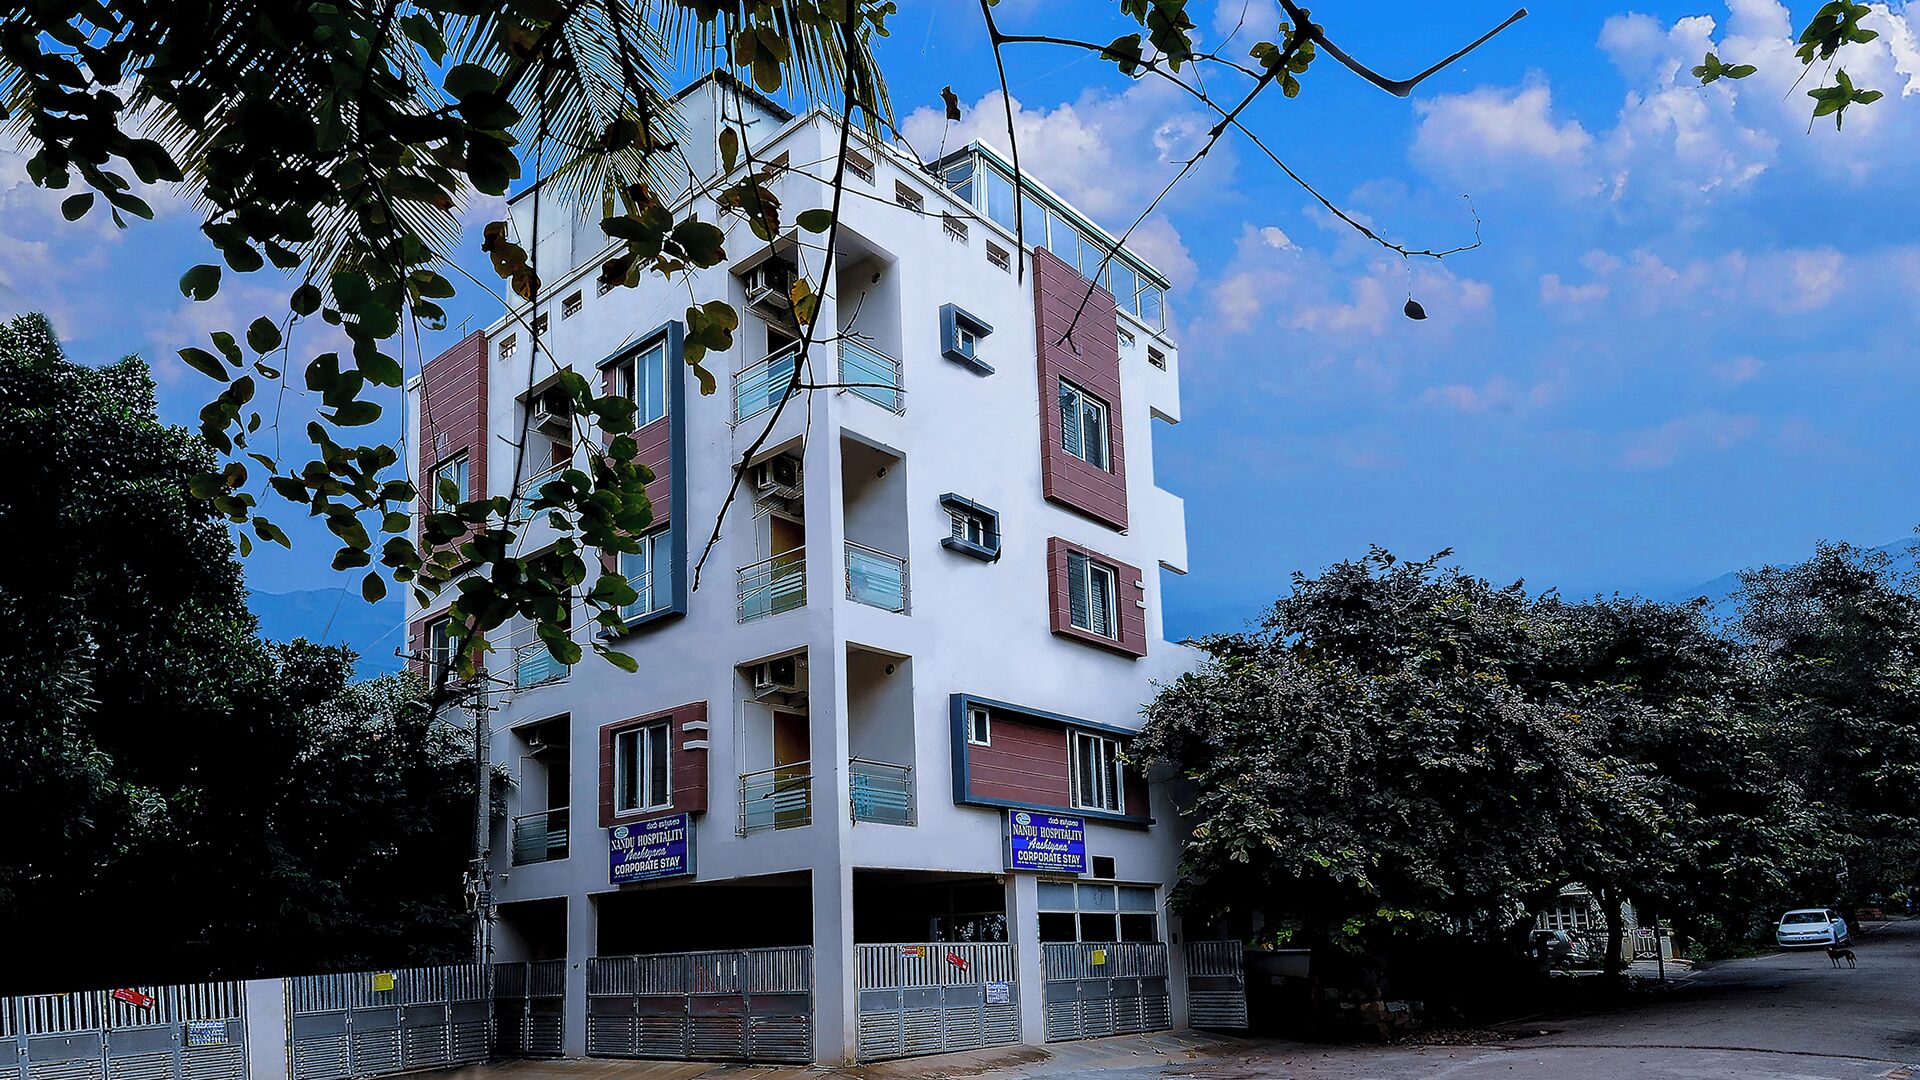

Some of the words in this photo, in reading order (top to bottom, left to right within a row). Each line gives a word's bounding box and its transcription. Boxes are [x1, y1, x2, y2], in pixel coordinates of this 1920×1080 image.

[611, 837, 635, 851] NANDU
[638, 827, 685, 847] HOSPITALITY
[1013, 824, 1038, 837] NANDU
[1040, 827, 1083, 841] HOSPITALITY
[615, 859, 659, 875] CORPORATE
[660, 856, 680, 869] STAY
[1018, 850, 1062, 863] CORPORATE
[1062, 854, 1080, 864] STAY
